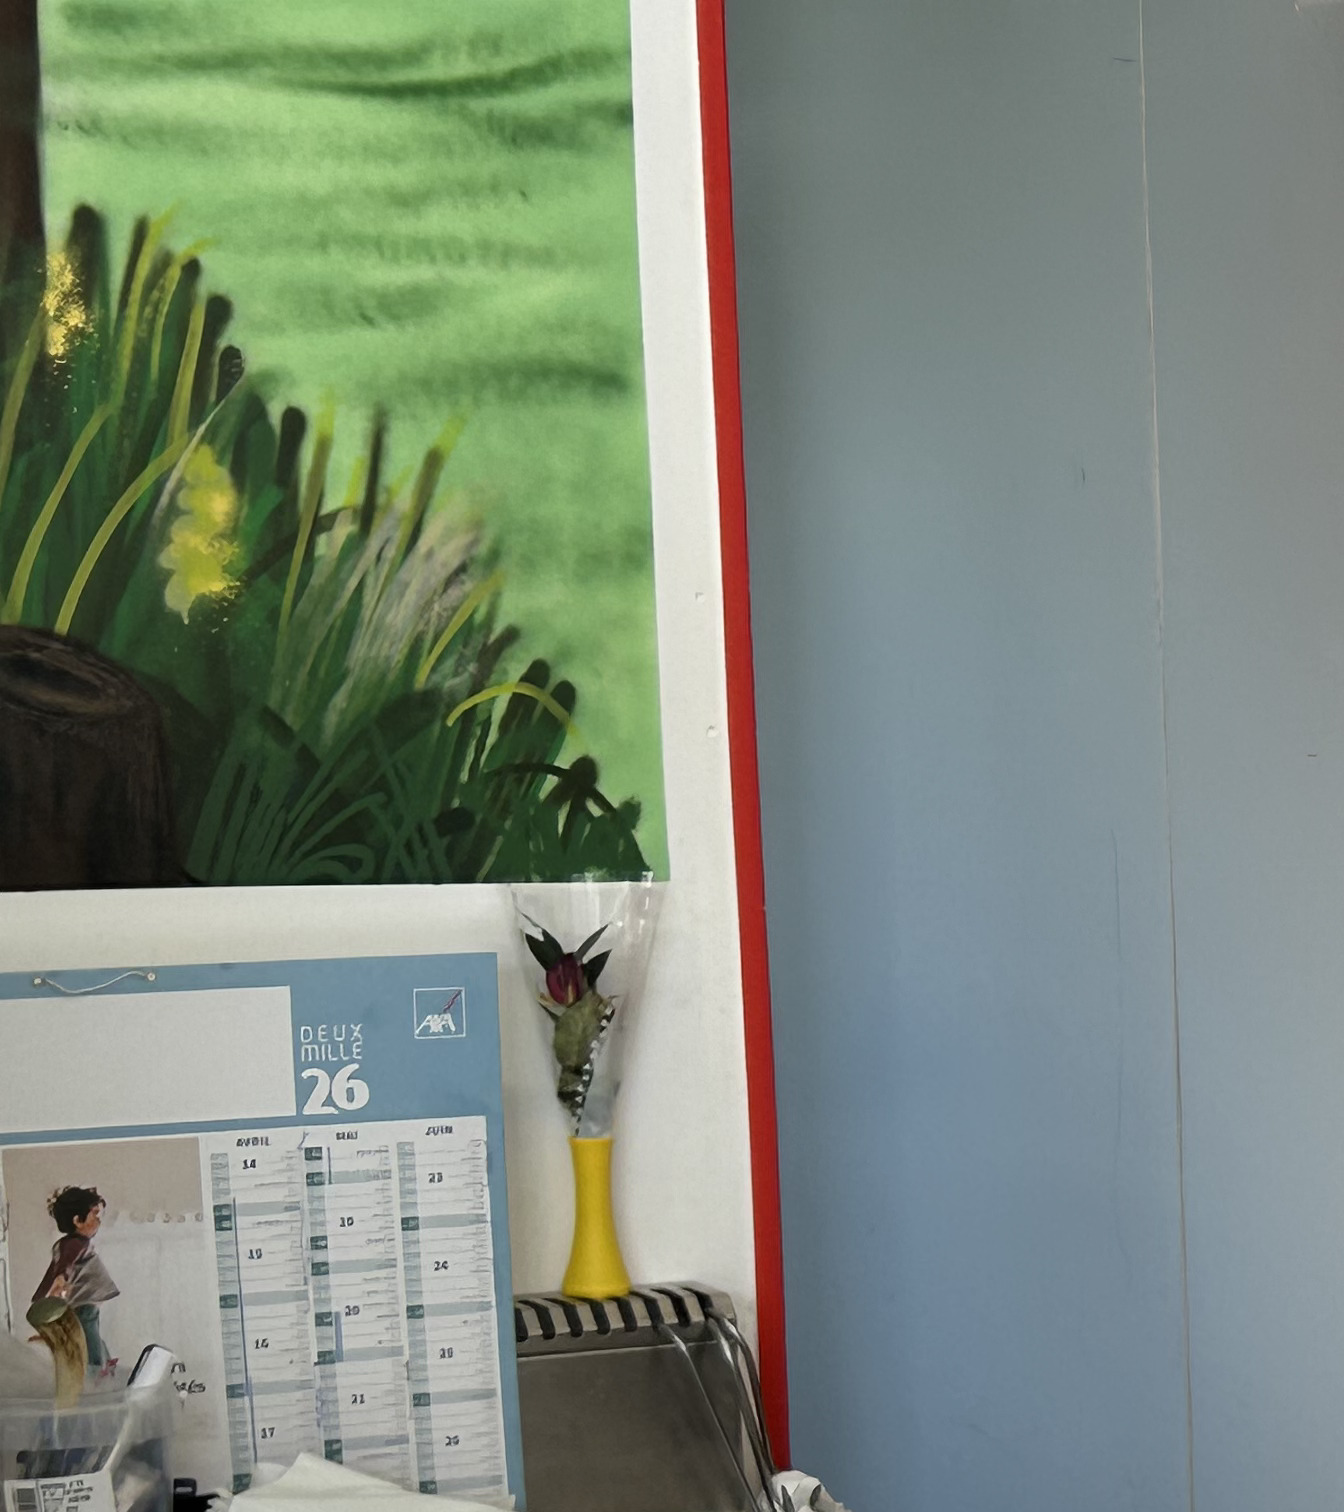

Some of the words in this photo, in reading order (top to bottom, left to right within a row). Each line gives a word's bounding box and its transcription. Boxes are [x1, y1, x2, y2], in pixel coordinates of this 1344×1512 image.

[300, 1023, 364, 1043] DEUX
[415, 1012, 457, 1036] AXA
[300, 1042, 364, 1063] MILLE
[300, 1063, 371, 1116] 26
